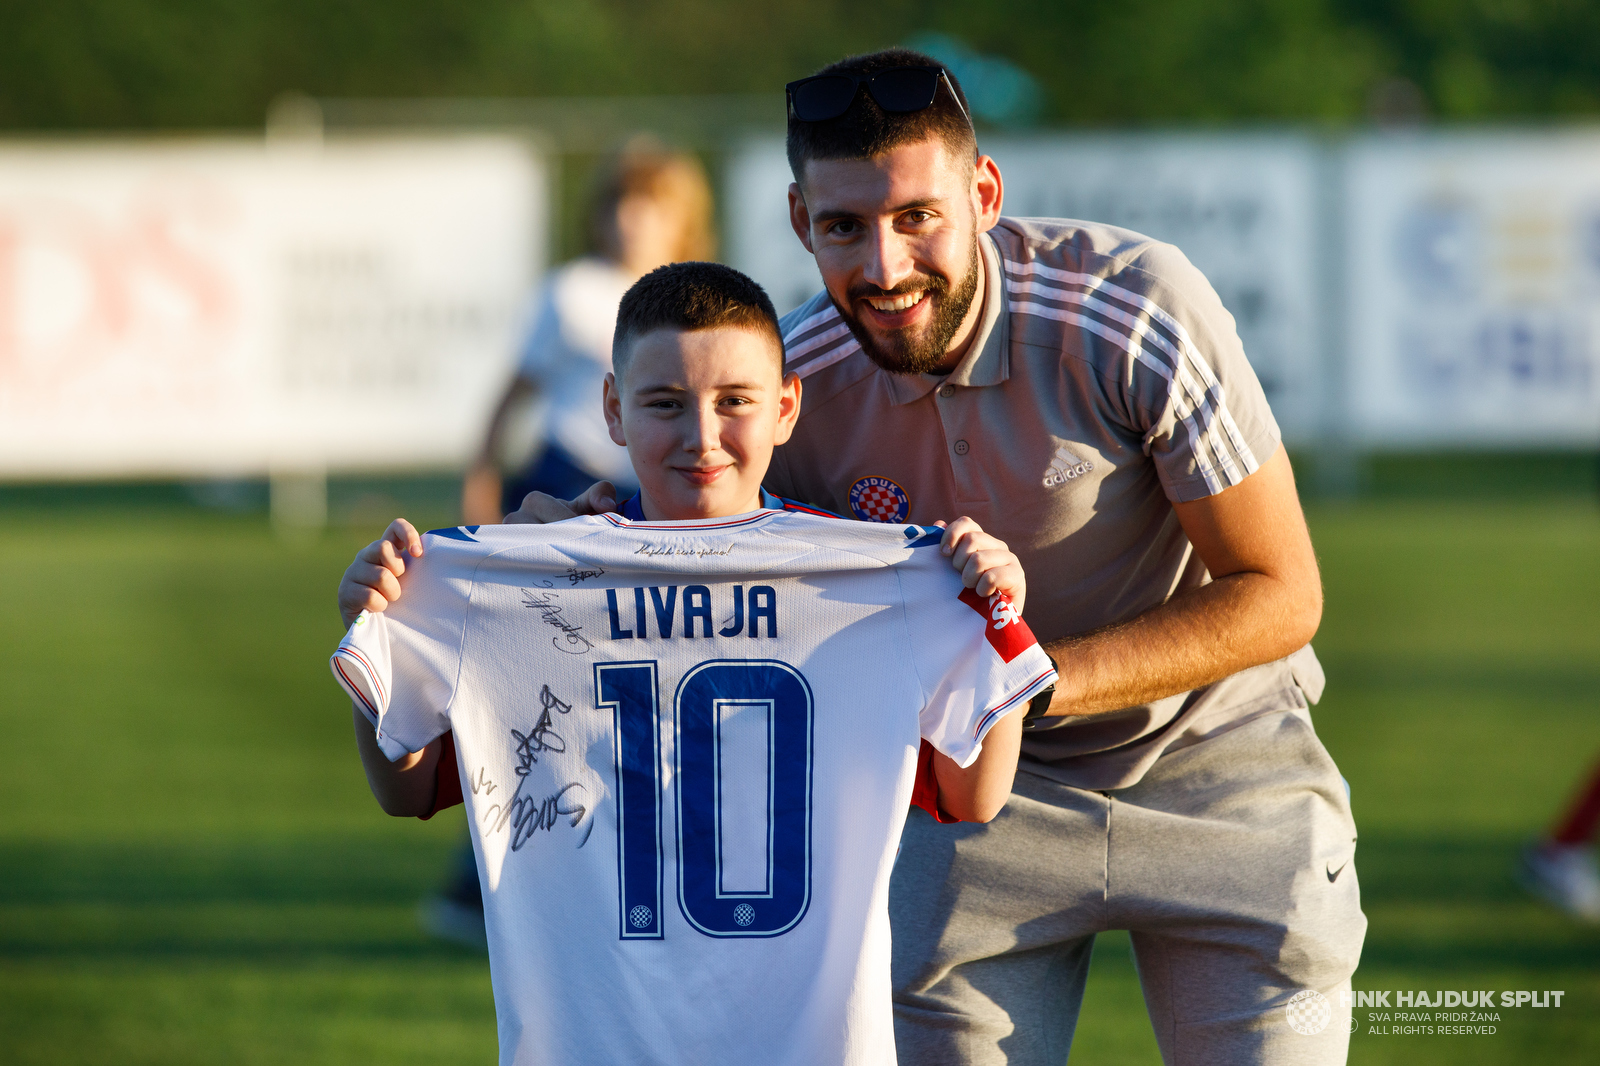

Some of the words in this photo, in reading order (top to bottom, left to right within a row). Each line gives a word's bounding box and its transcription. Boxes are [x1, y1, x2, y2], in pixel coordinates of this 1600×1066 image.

[851, 478, 898, 498] HAJDUK
[1044, 461, 1094, 487] adidas
[606, 585, 778, 640] LIVAJA
[593, 659, 815, 940] 10
